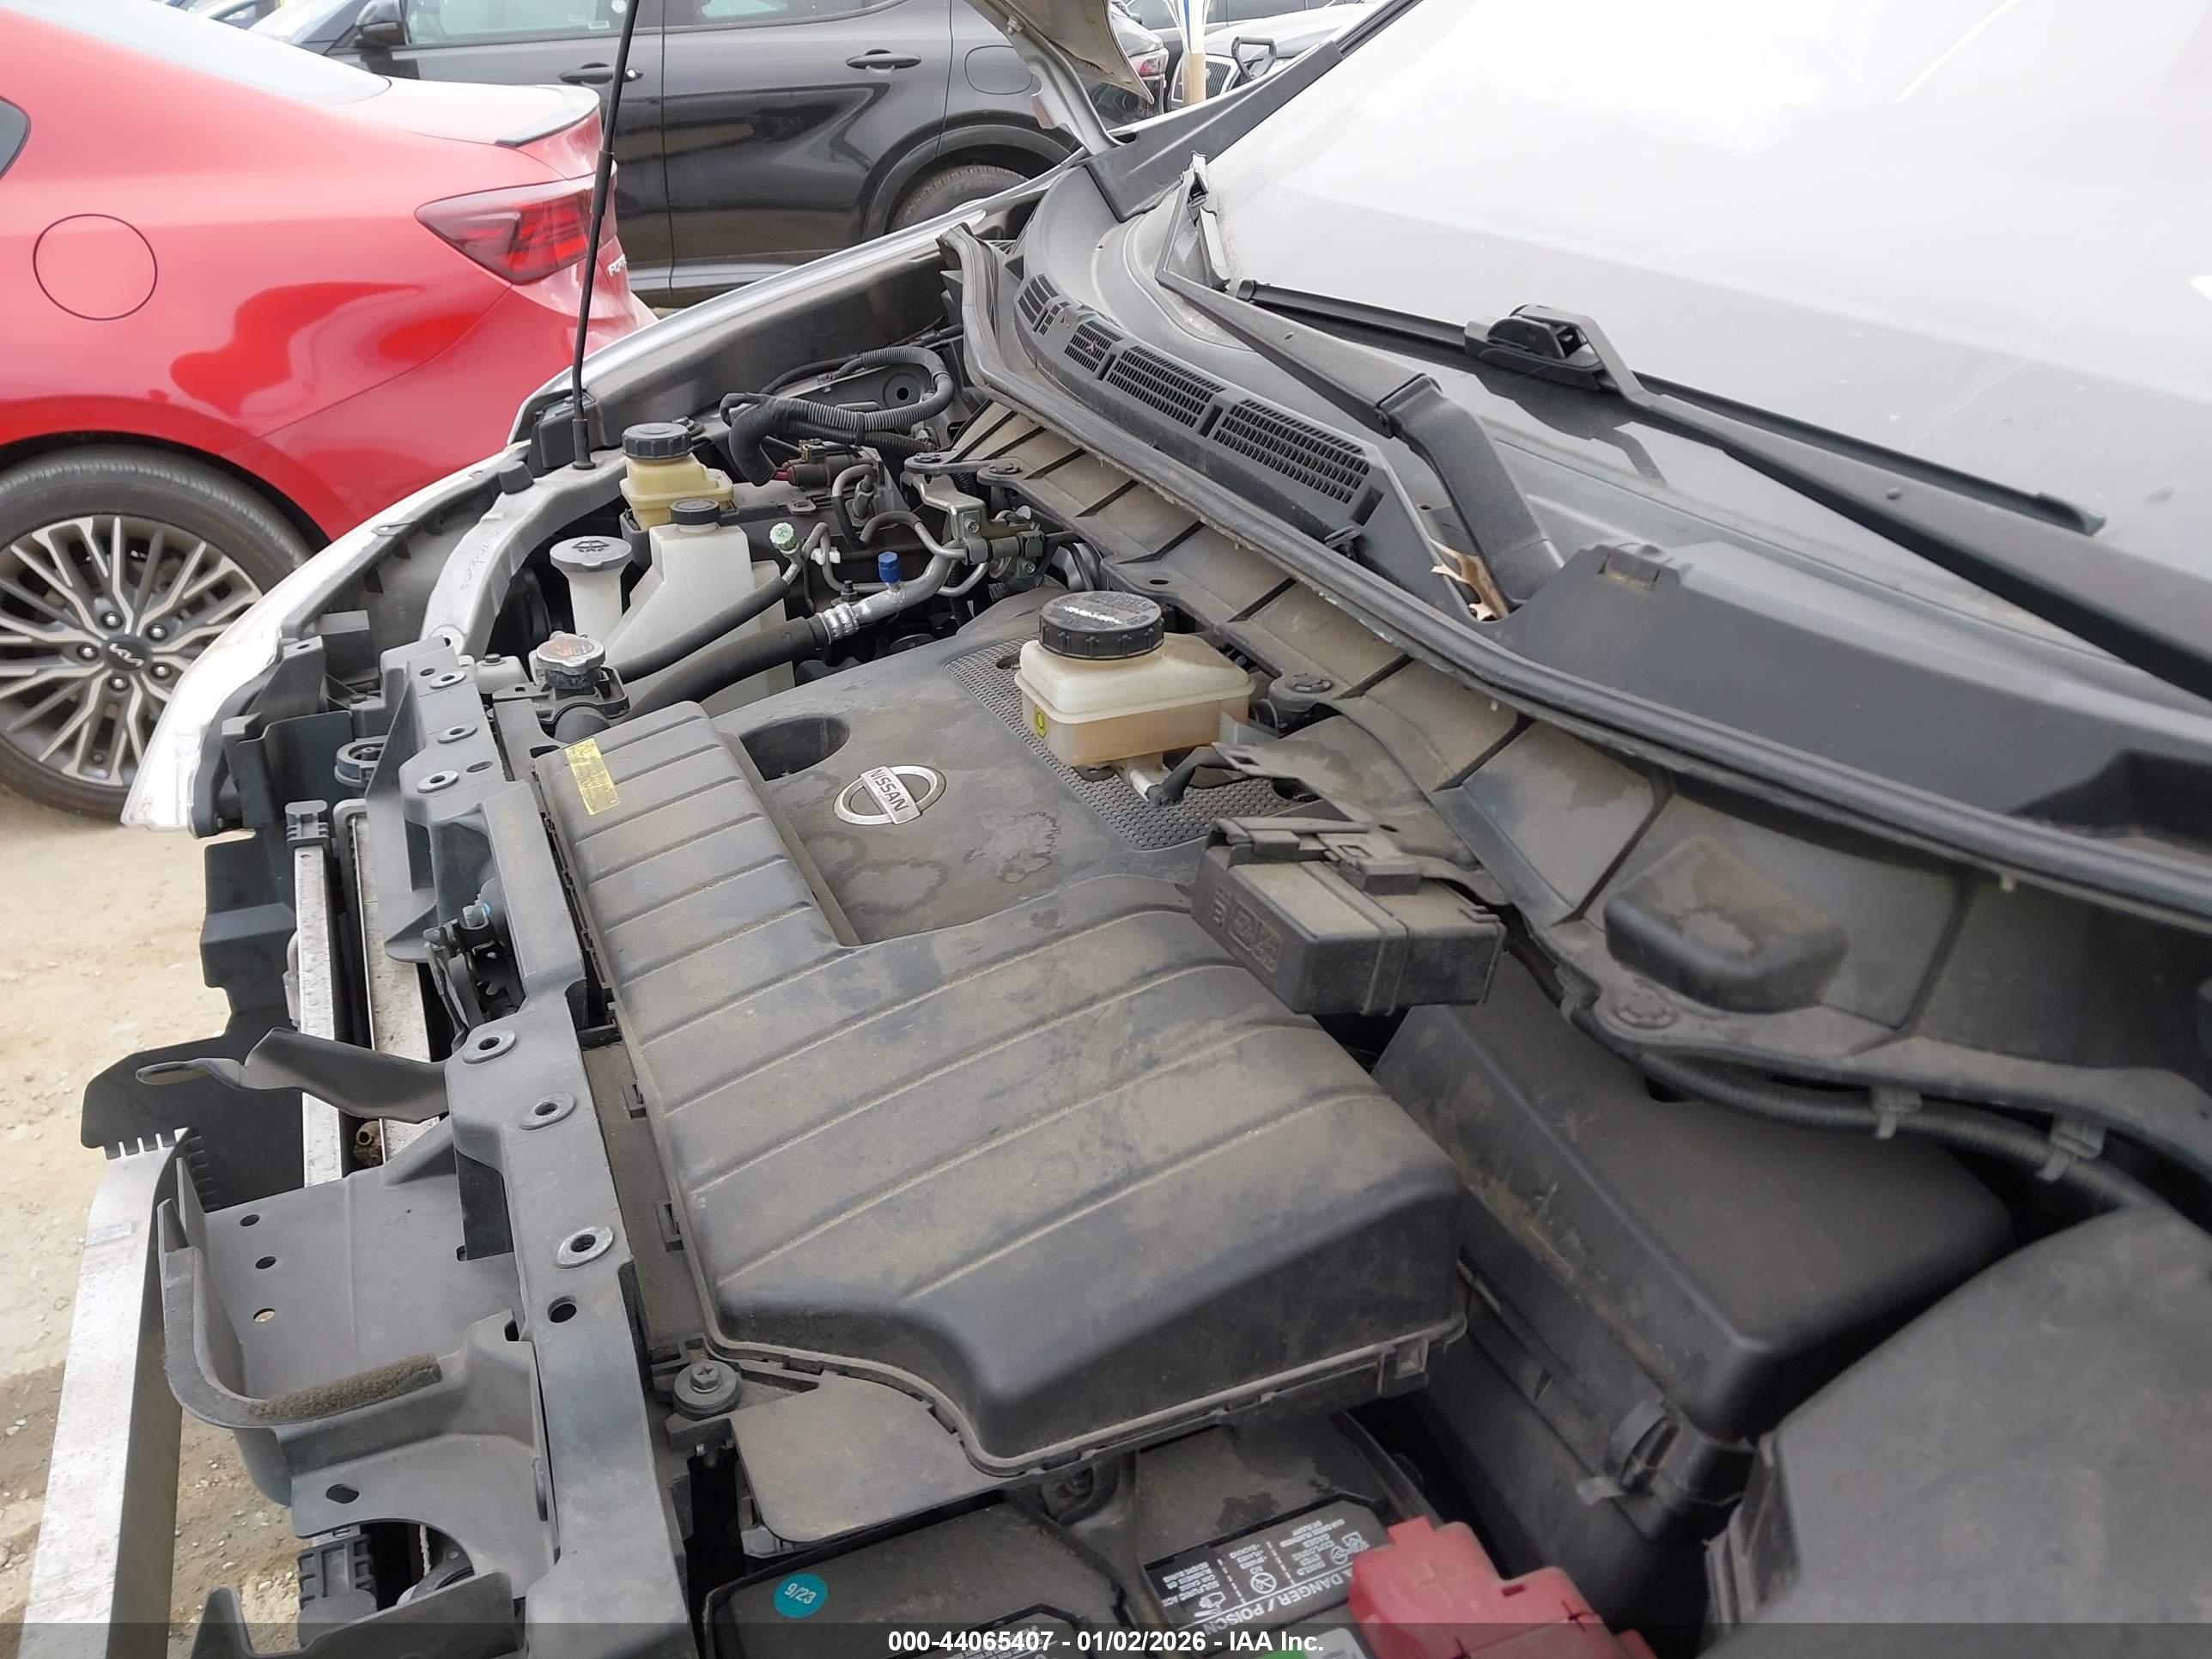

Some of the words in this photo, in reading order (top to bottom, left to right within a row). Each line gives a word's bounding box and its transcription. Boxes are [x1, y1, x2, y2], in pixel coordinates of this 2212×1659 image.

[869, 769, 908, 812] NISSAN
[783, 1583, 817, 1605] 9/23
[1279, 1576, 1343, 1606] DANGER
